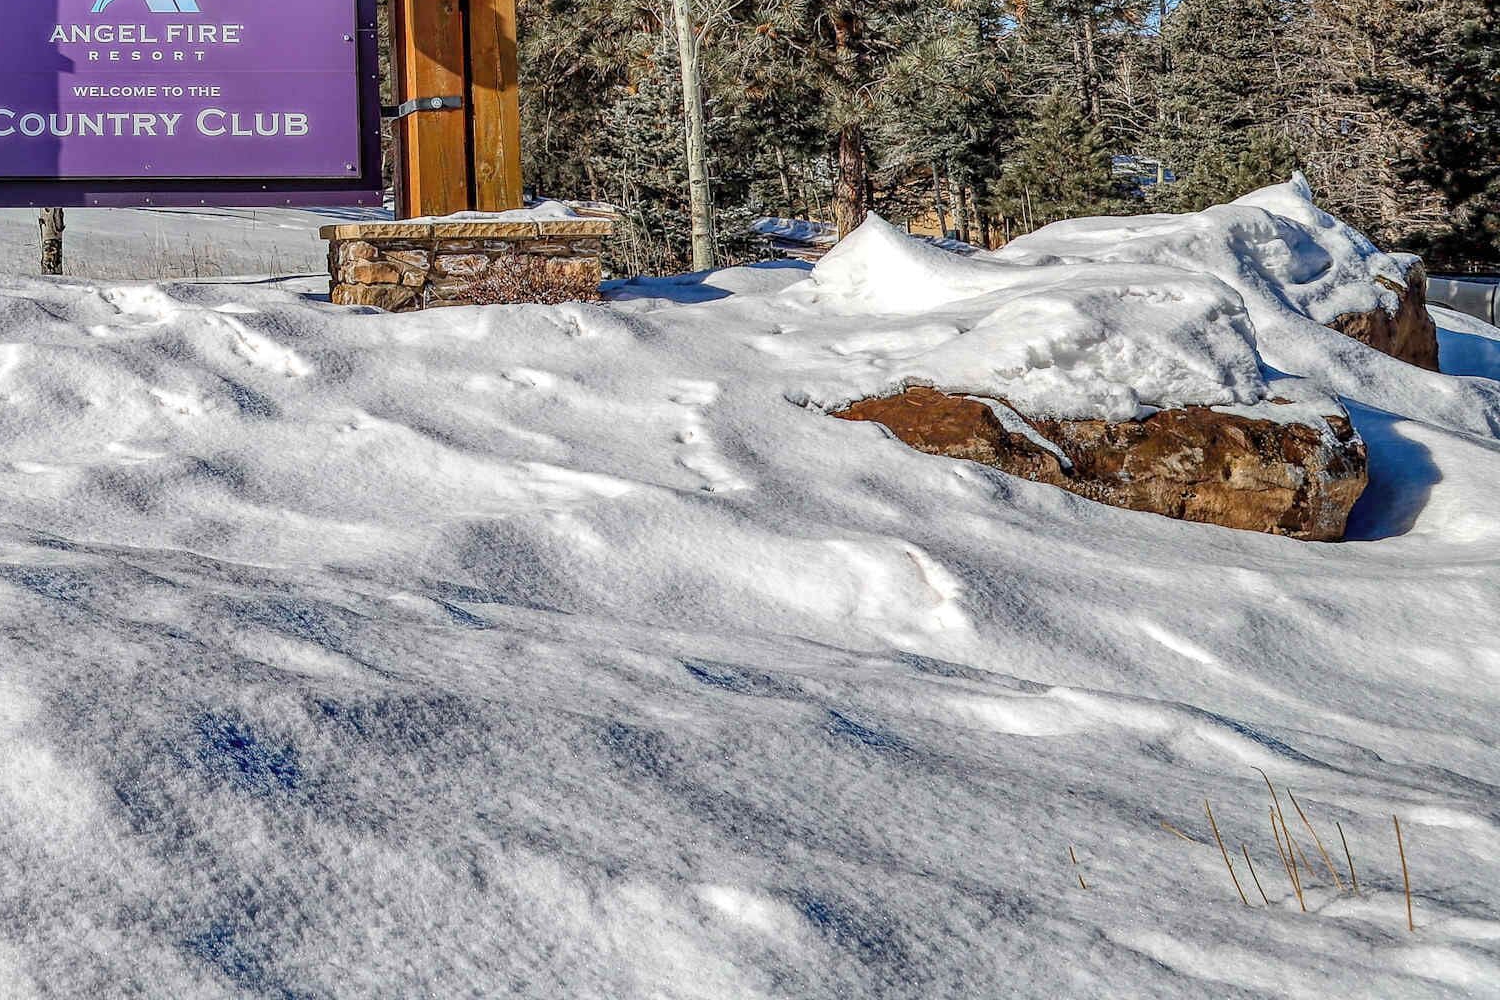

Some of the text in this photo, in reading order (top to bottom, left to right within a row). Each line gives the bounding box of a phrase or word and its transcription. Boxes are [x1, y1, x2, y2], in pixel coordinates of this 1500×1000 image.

[49, 24, 240, 44] ANGEL FIRE
[88, 51, 205, 61] RESORT
[72, 86, 221, 97] WELCOME TO THE
[196, 108, 309, 137] CLUB
